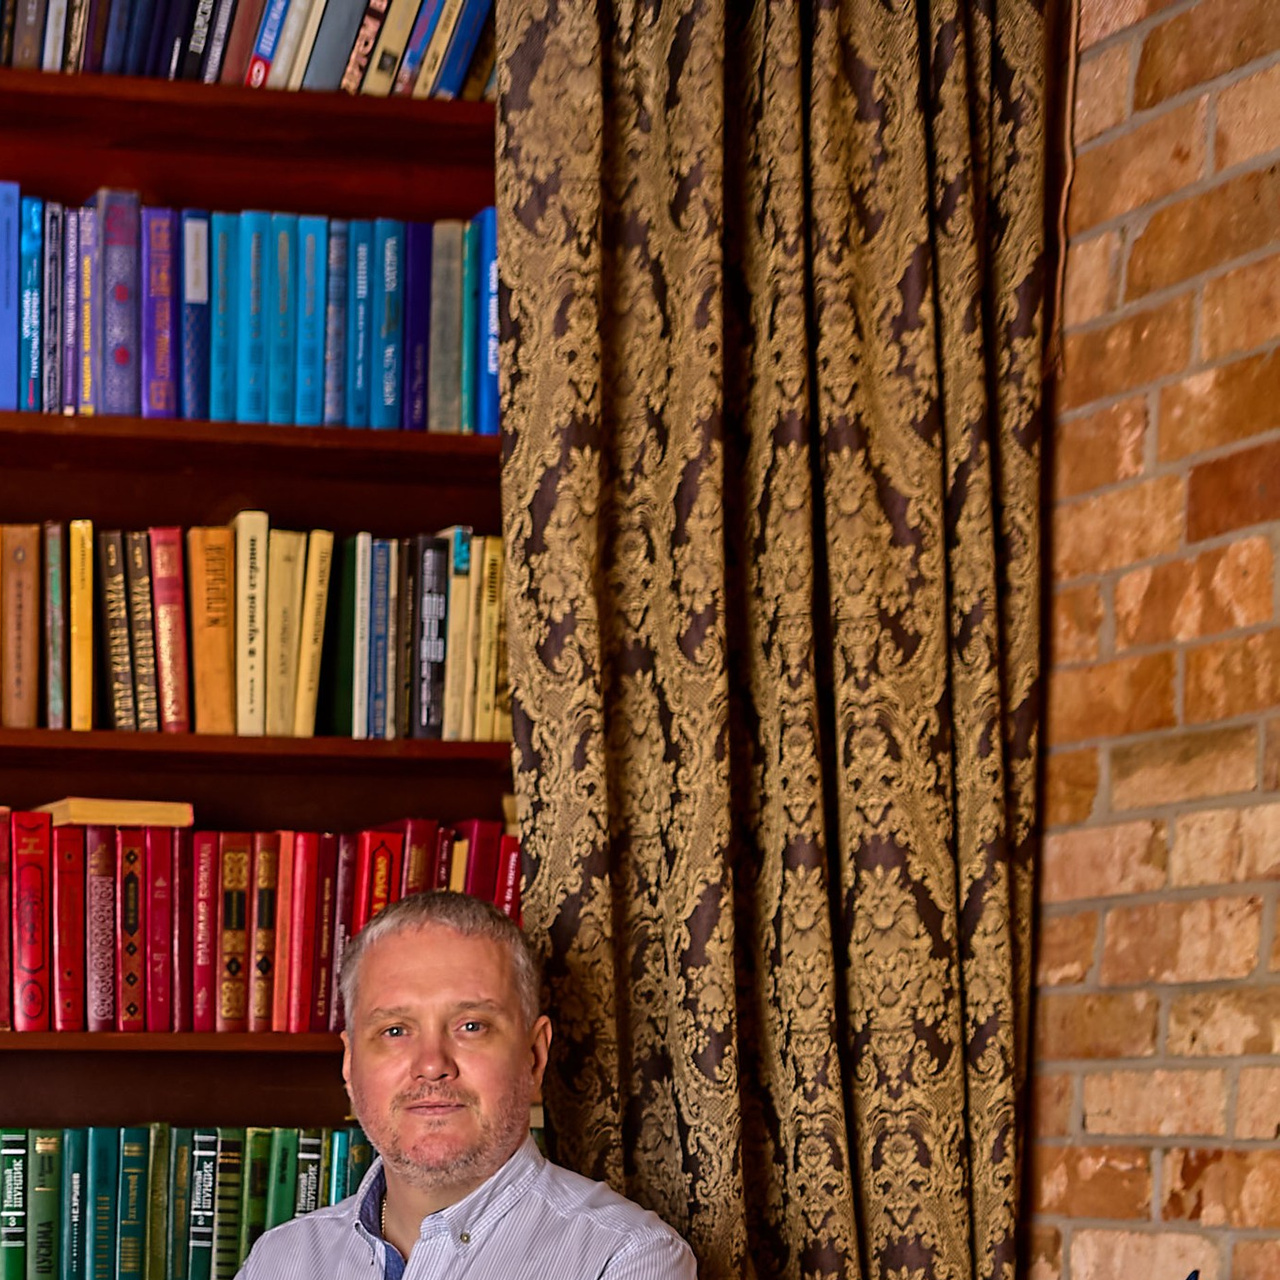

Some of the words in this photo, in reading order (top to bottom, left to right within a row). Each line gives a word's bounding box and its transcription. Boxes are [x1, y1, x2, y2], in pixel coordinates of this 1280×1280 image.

[4, 1168, 14, 1207] Николай
[12, 1159, 23, 1208] ШУНДИК
[193, 1170, 203, 1208] Николай
[201, 1161, 213, 1209] ШУНДИК
[297, 1173, 308, 1211] Николай
[306, 1164, 318, 1211] ШУНДИК
[9, 1217, 16, 1226] 3
[198, 1216, 205, 1225] 2
[36, 1221, 53, 1274] ЦУСИМА
